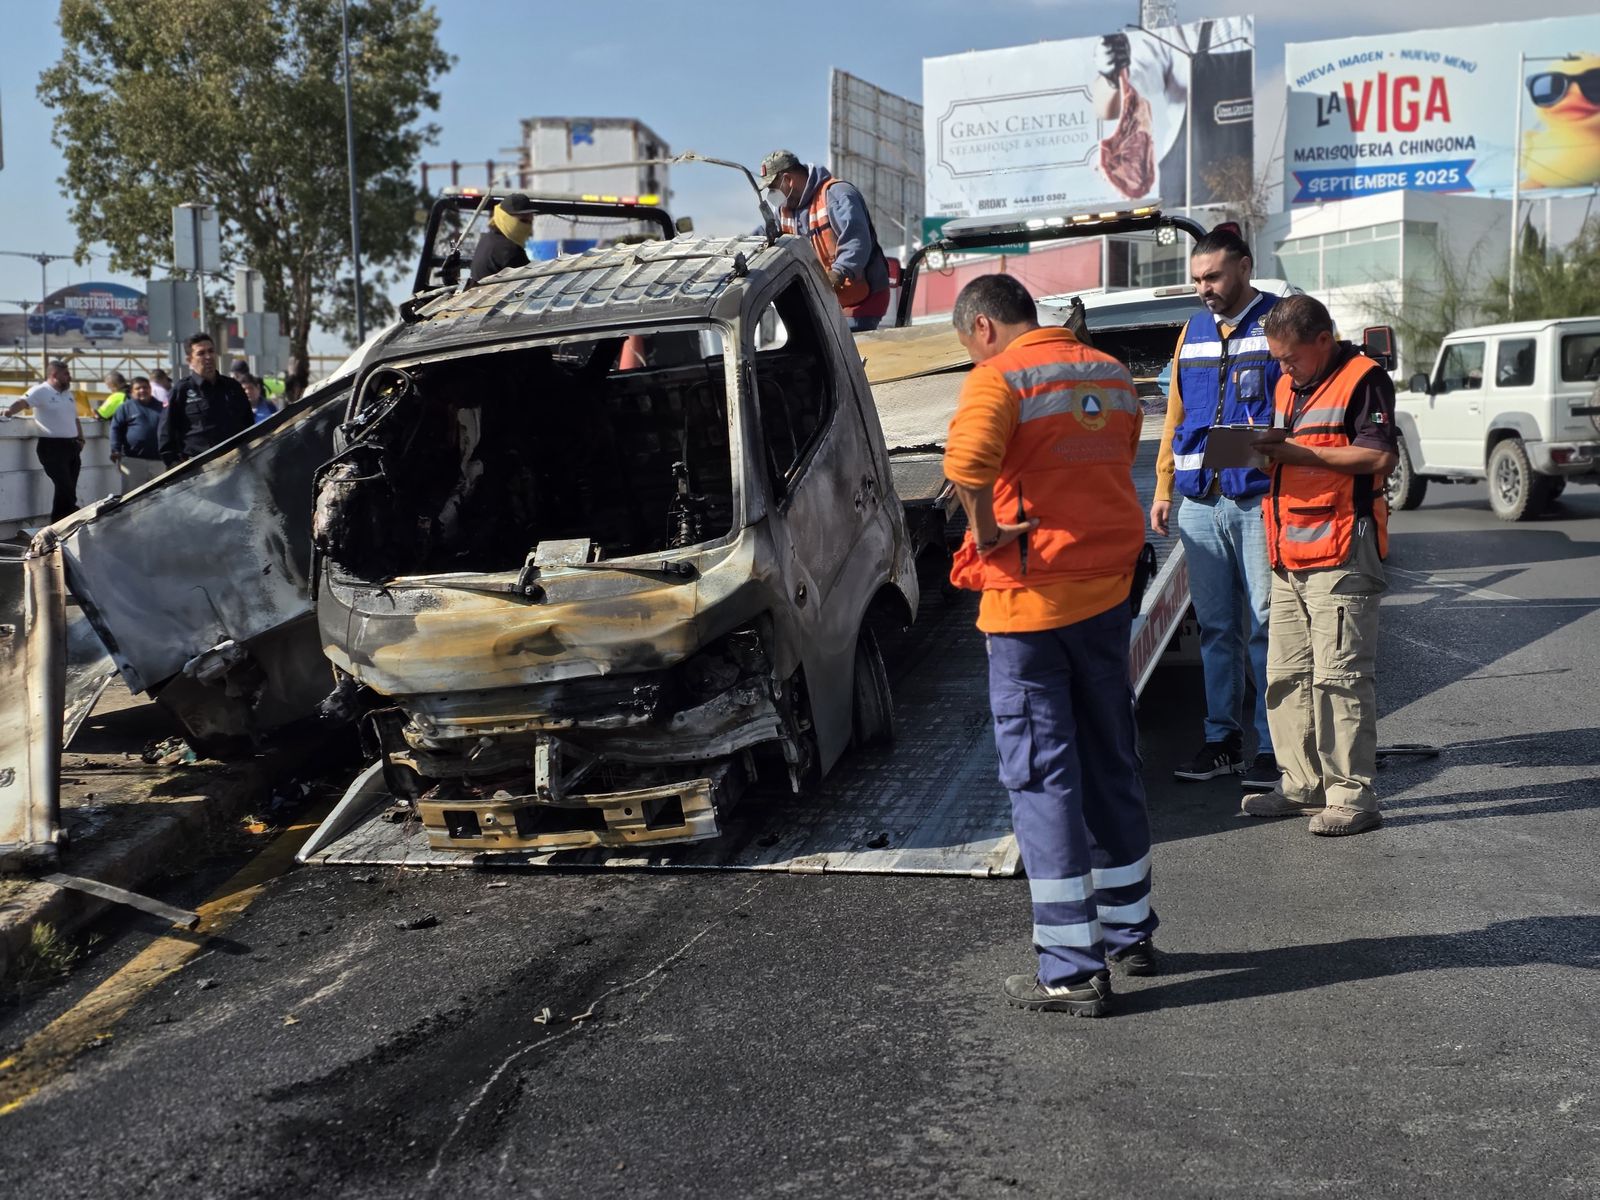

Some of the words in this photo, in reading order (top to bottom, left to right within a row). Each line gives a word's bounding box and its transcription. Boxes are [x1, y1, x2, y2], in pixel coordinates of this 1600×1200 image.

[1296, 63, 1336, 88] NUEVA
[1339, 50, 1384, 68] IMAGEN
[1400, 49, 1442, 64] NUEVO
[1444, 55, 1478, 74] MENÚ
[1316, 91, 1341, 127] LA
[1343, 71, 1452, 133] VIGA
[951, 119, 999, 139] GRAN
[1006, 110, 1089, 133] CENTRAL
[949, 139, 1020, 156] STEAKHOUSE
[1024, 138, 1032, 148] &
[1035, 132, 1089, 147] SEAFOOD
[1294, 141, 1393, 163] MARISQUERIA
[1399, 135, 1476, 156] CHINGONA
[1308, 171, 1408, 193] SEPTIEMBRE
[1414, 168, 1460, 187] 2025
[978, 198, 1007, 210] BRONX
[64, 296, 139, 310] INDESTRUCTIBLES
